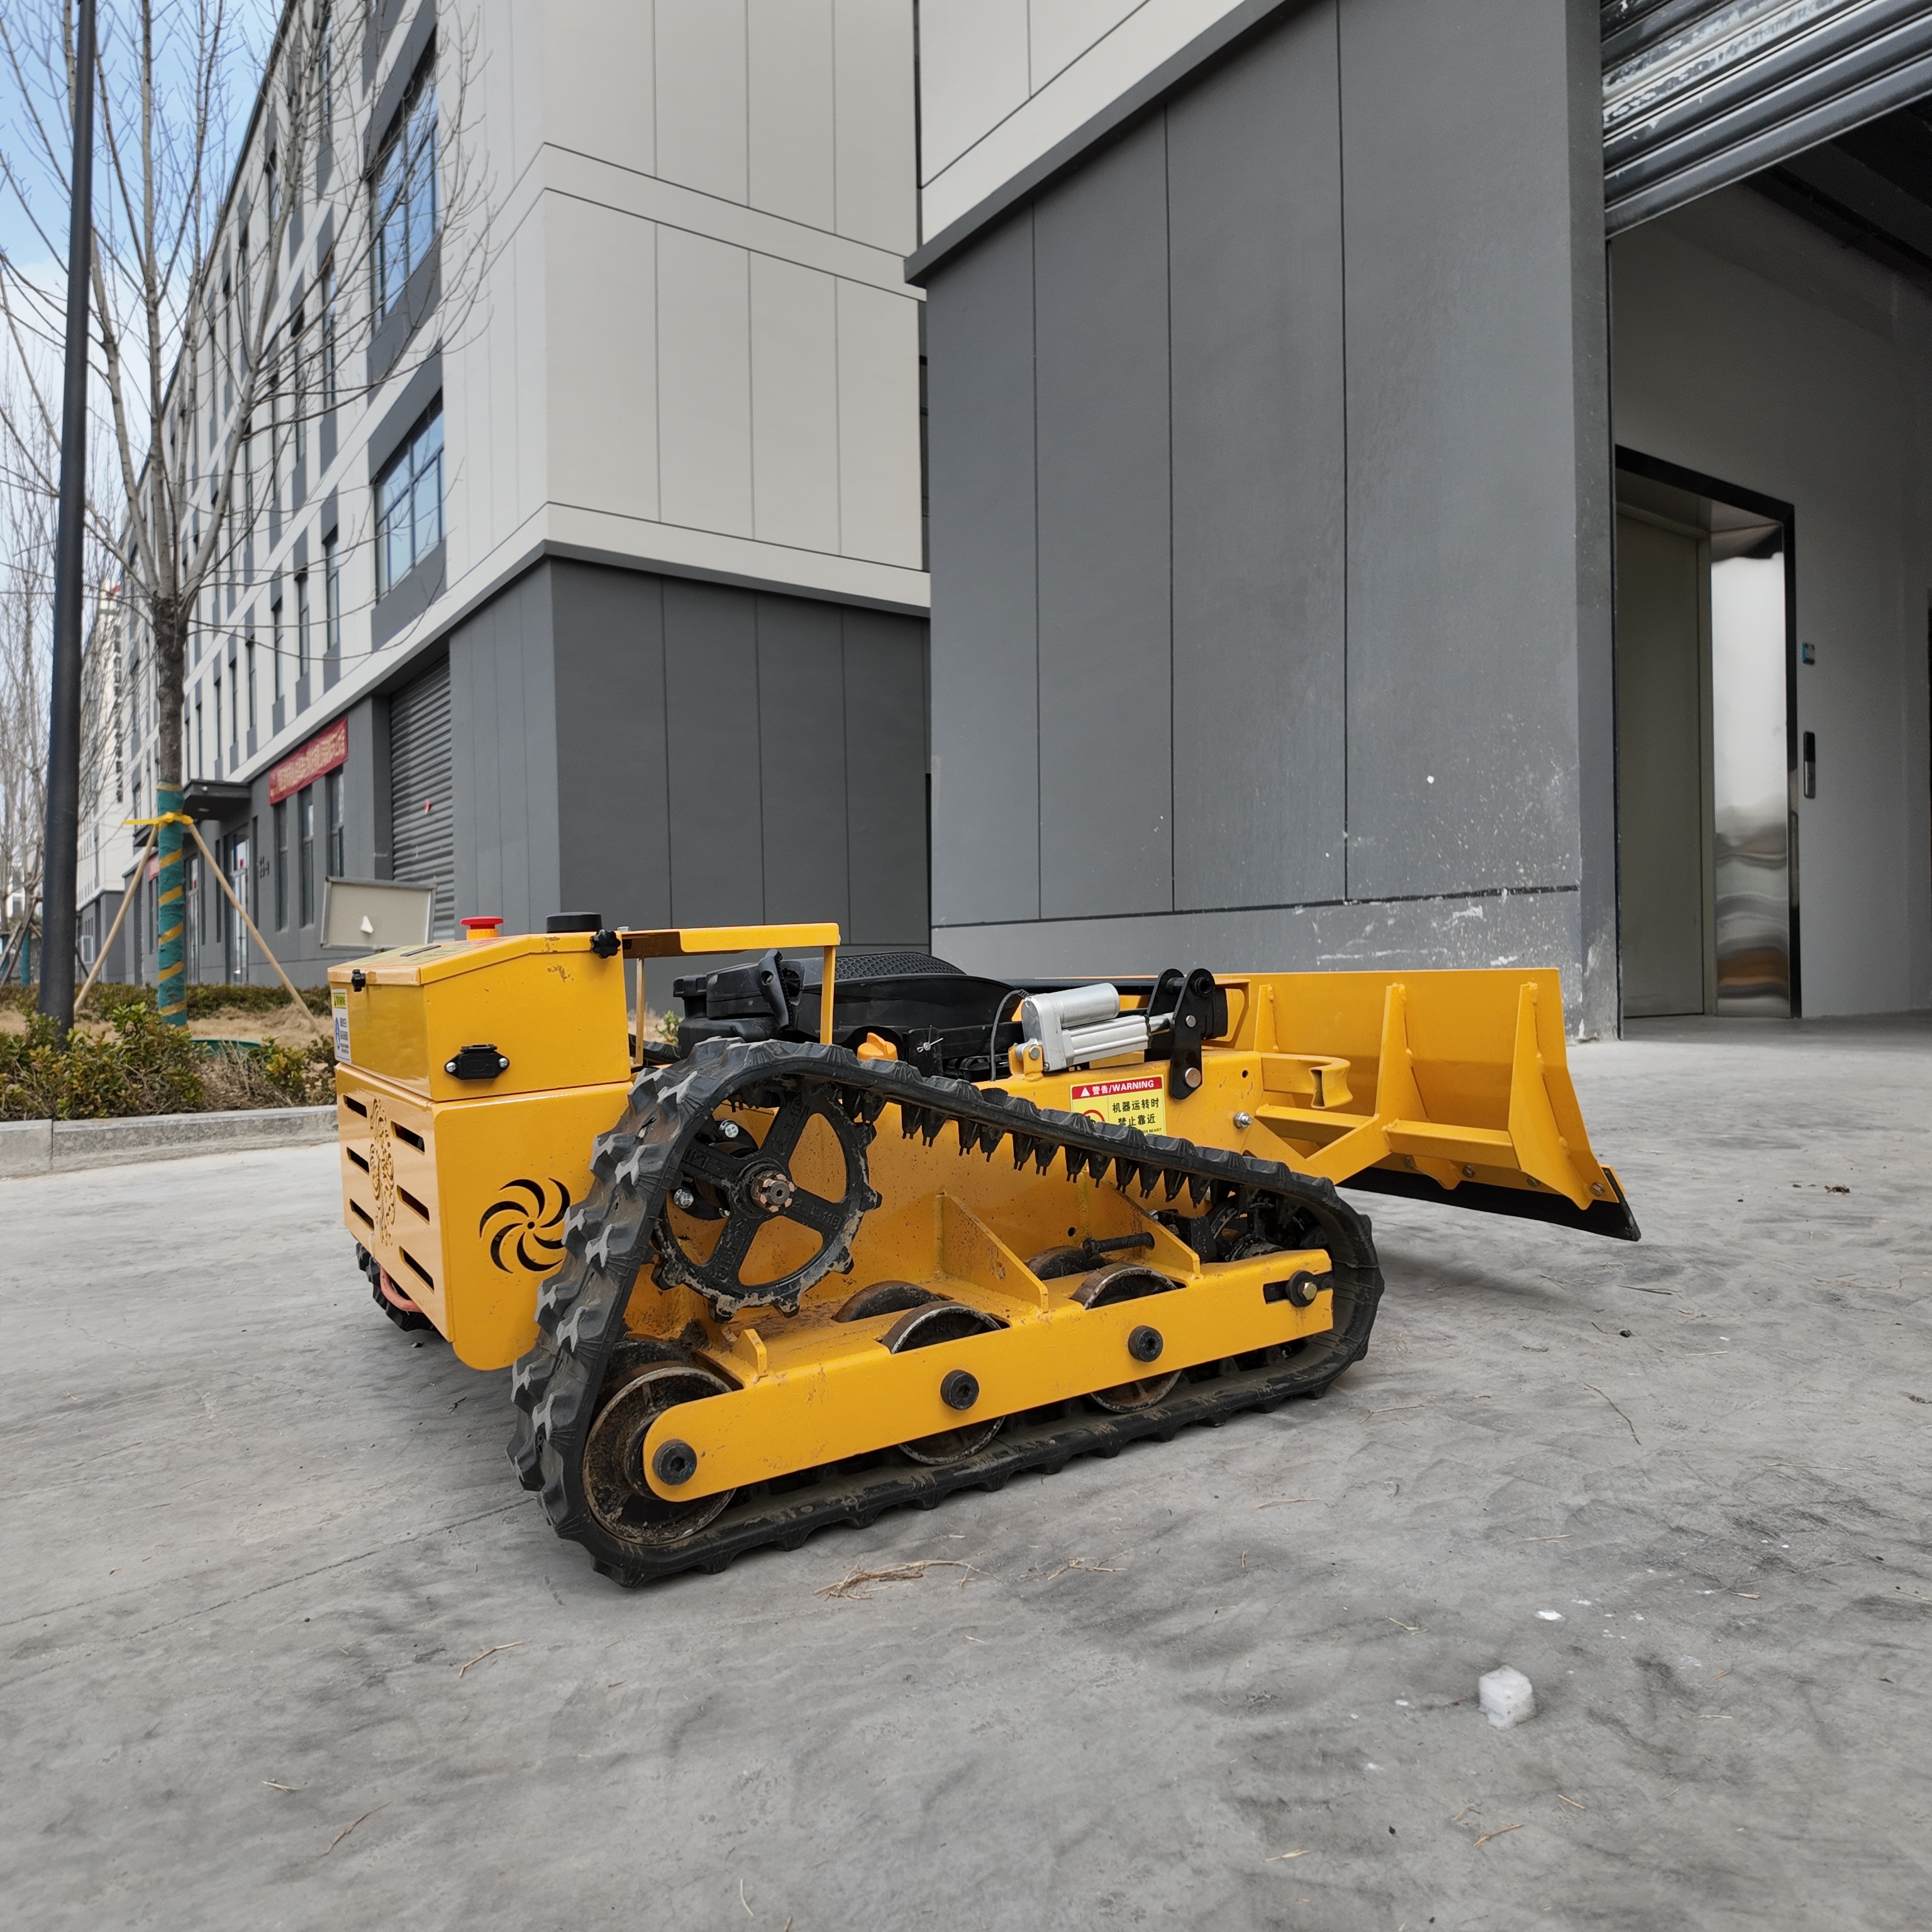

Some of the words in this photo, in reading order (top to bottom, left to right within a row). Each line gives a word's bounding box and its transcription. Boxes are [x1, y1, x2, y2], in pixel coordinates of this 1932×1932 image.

[1092, 1080, 1154, 1095] 警告/WARNING
[1112, 1097, 1160, 1113] 机器运转时
[1118, 1113, 1156, 1127] 禁止靠近
